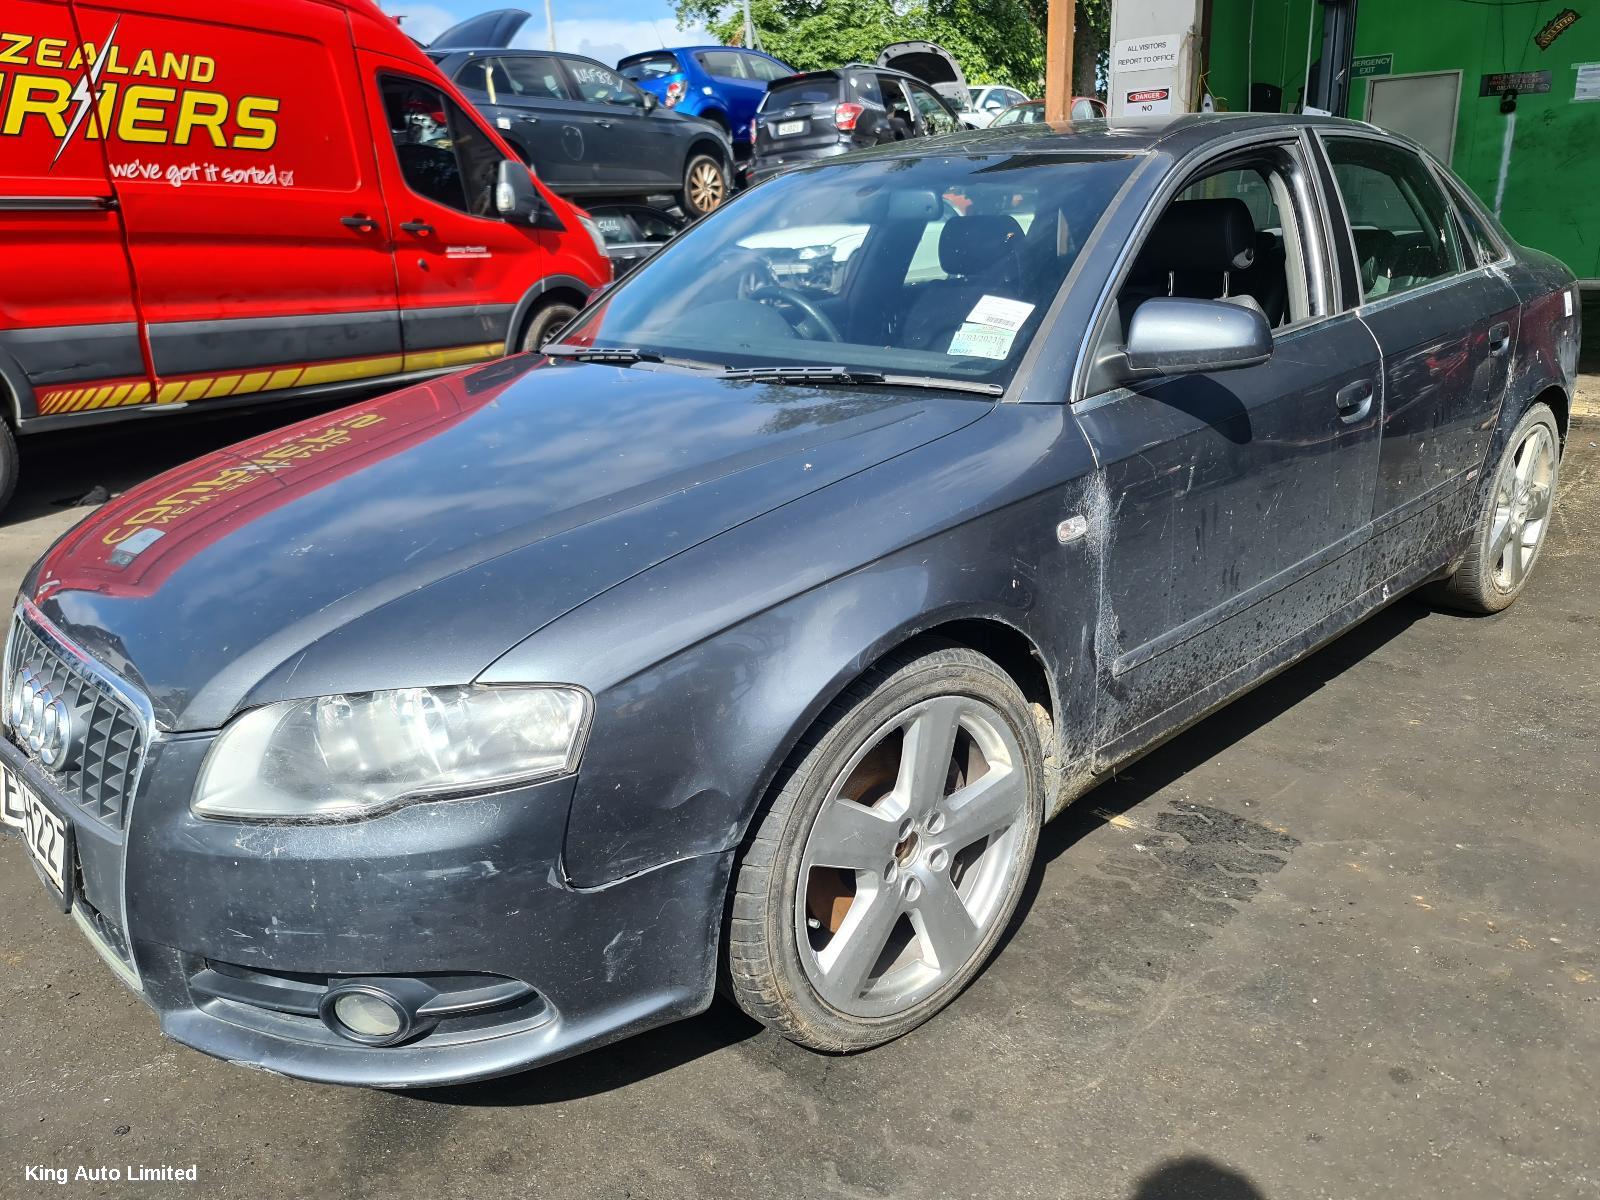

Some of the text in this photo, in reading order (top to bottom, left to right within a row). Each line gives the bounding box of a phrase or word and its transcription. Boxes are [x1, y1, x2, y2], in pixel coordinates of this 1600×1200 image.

[1139, 41, 1167, 51] VISITORS
[0, 33, 215, 83] ZEALAND
[1117, 57, 1142, 66] REPORT
[1152, 53, 1175, 63] OFFICE
[1352, 57, 1390, 67] MERGENCY
[1360, 66, 1375, 74] EXIT
[1135, 92, 1160, 100] DANGER
[0, 73, 279, 150] RIERS
[1141, 104, 1153, 112] NO
[109, 159, 277, 188] we've got it sorted
